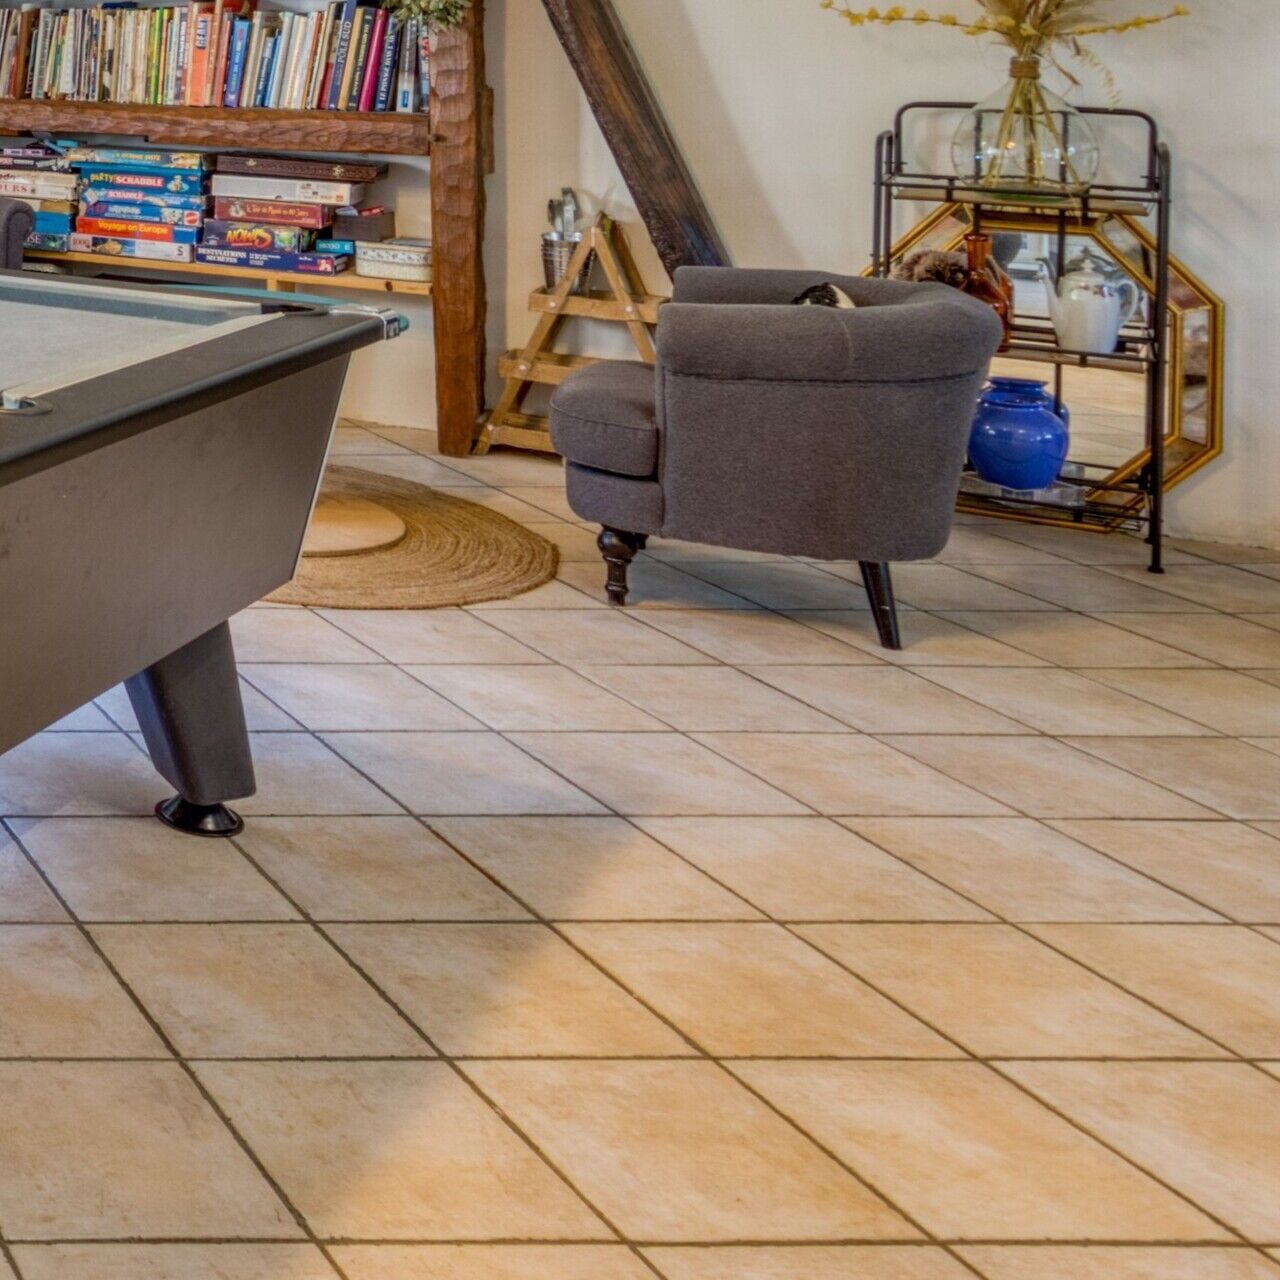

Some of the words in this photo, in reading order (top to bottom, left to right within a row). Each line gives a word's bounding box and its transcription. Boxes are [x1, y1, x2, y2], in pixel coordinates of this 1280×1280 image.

[342, 21, 352, 39] SUD
[337, 39, 348, 64] PÔLE
[90, 173, 113, 182] PARTY
[114, 175, 164, 187] SCRABBLE
[107, 190, 144, 200] SCRABBLE
[98, 220, 126, 232] Voyage
[139, 223, 168, 234] Europe
